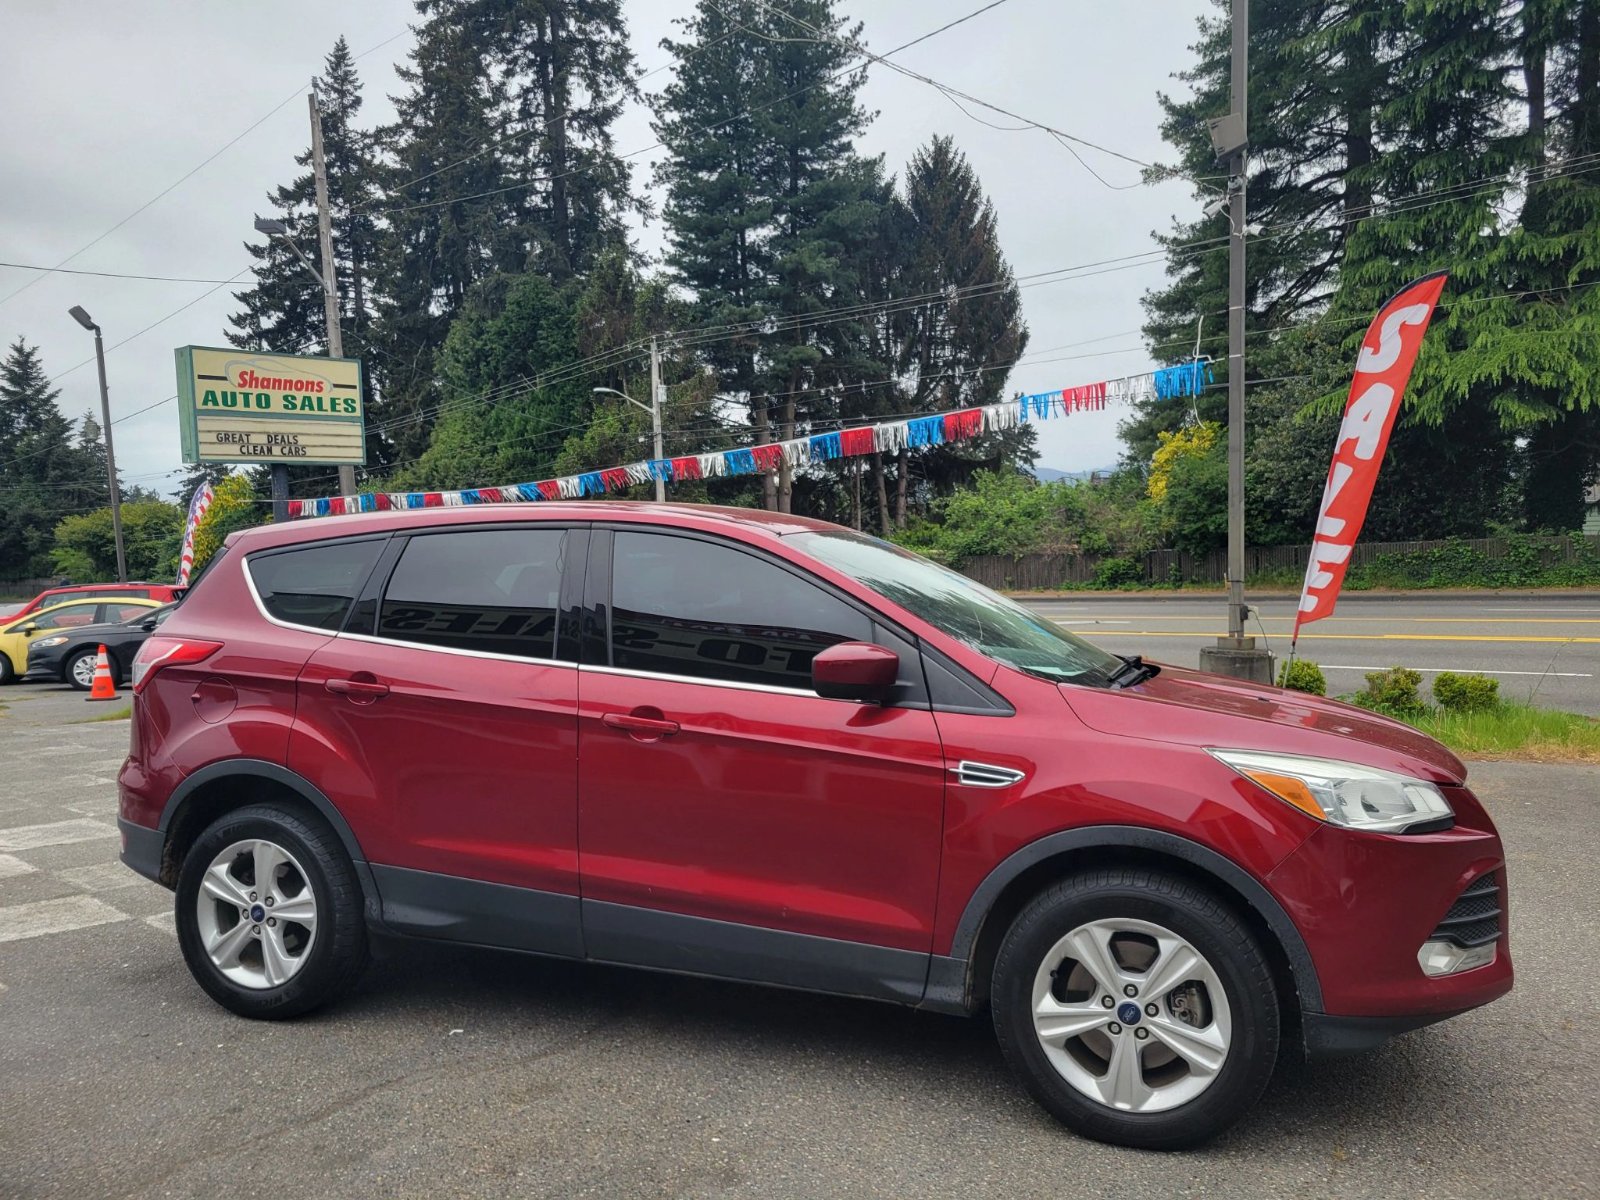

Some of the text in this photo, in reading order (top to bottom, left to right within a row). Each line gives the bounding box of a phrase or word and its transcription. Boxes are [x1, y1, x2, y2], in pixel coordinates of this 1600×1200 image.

[237, 370, 324, 393] Shannons
[202, 390, 357, 414] AUTO SALES
[216, 432, 299, 445] GREAT DEALS
[239, 444, 307, 456] CLEAN CARS
[1300, 303, 1430, 613] SALE
